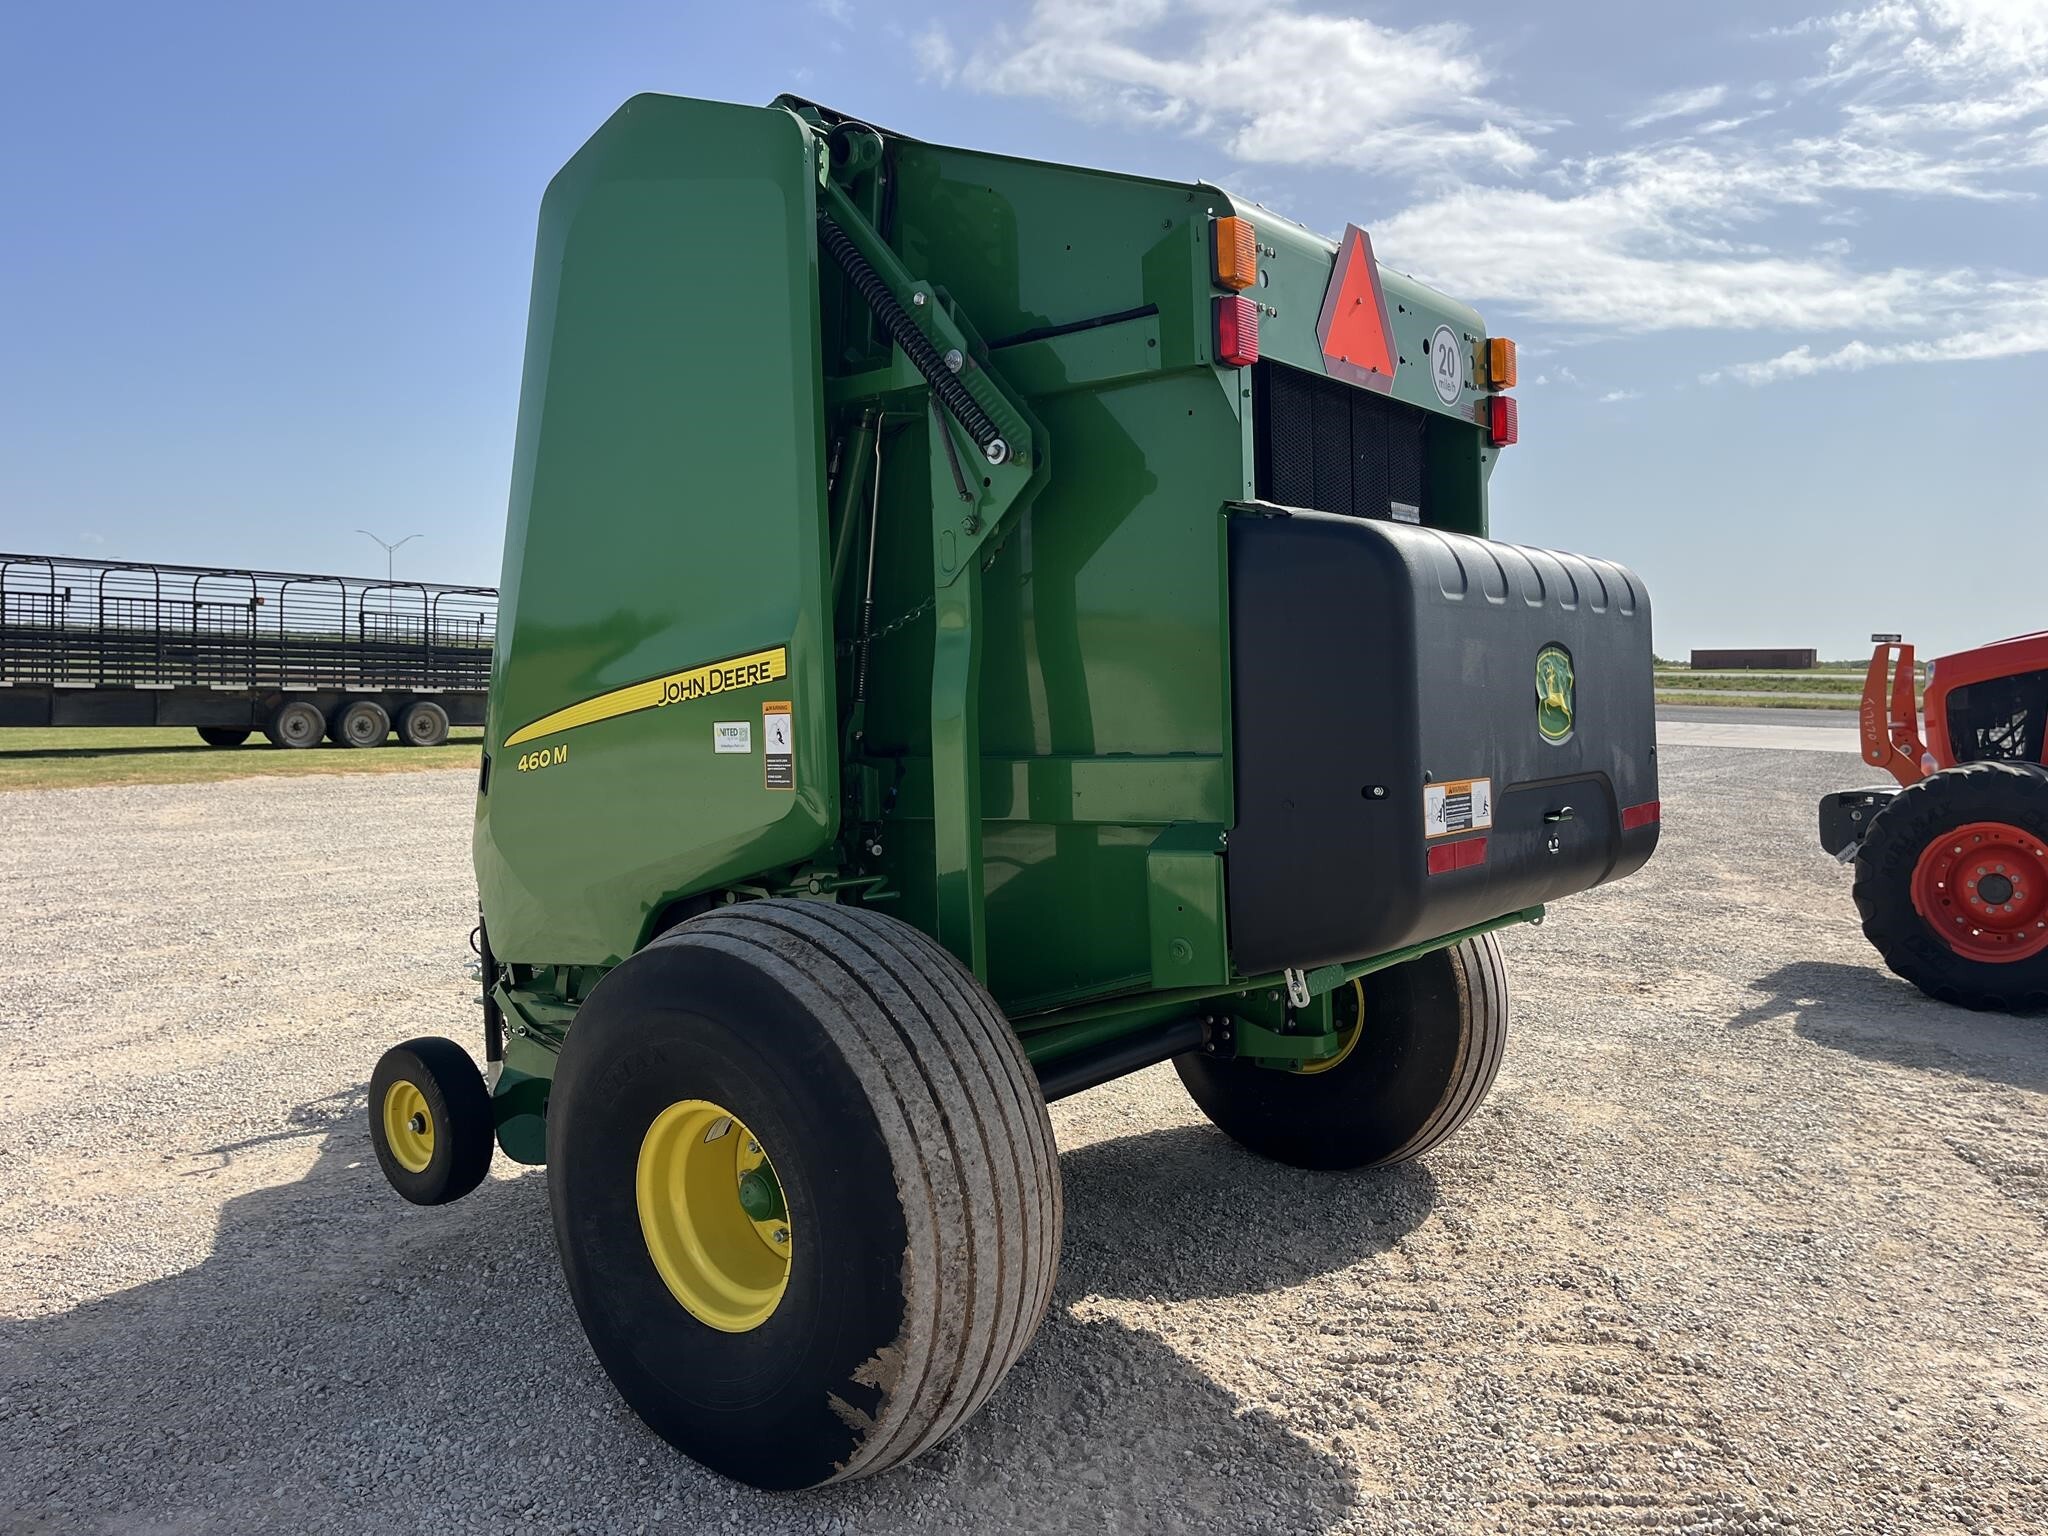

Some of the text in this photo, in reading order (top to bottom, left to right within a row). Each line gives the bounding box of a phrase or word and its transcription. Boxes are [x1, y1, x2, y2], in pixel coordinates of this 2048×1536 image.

[1438, 343, 1455, 378] 20
[658, 661, 771, 704] JOHN DEERE
[518, 744, 568, 772] 460 M
